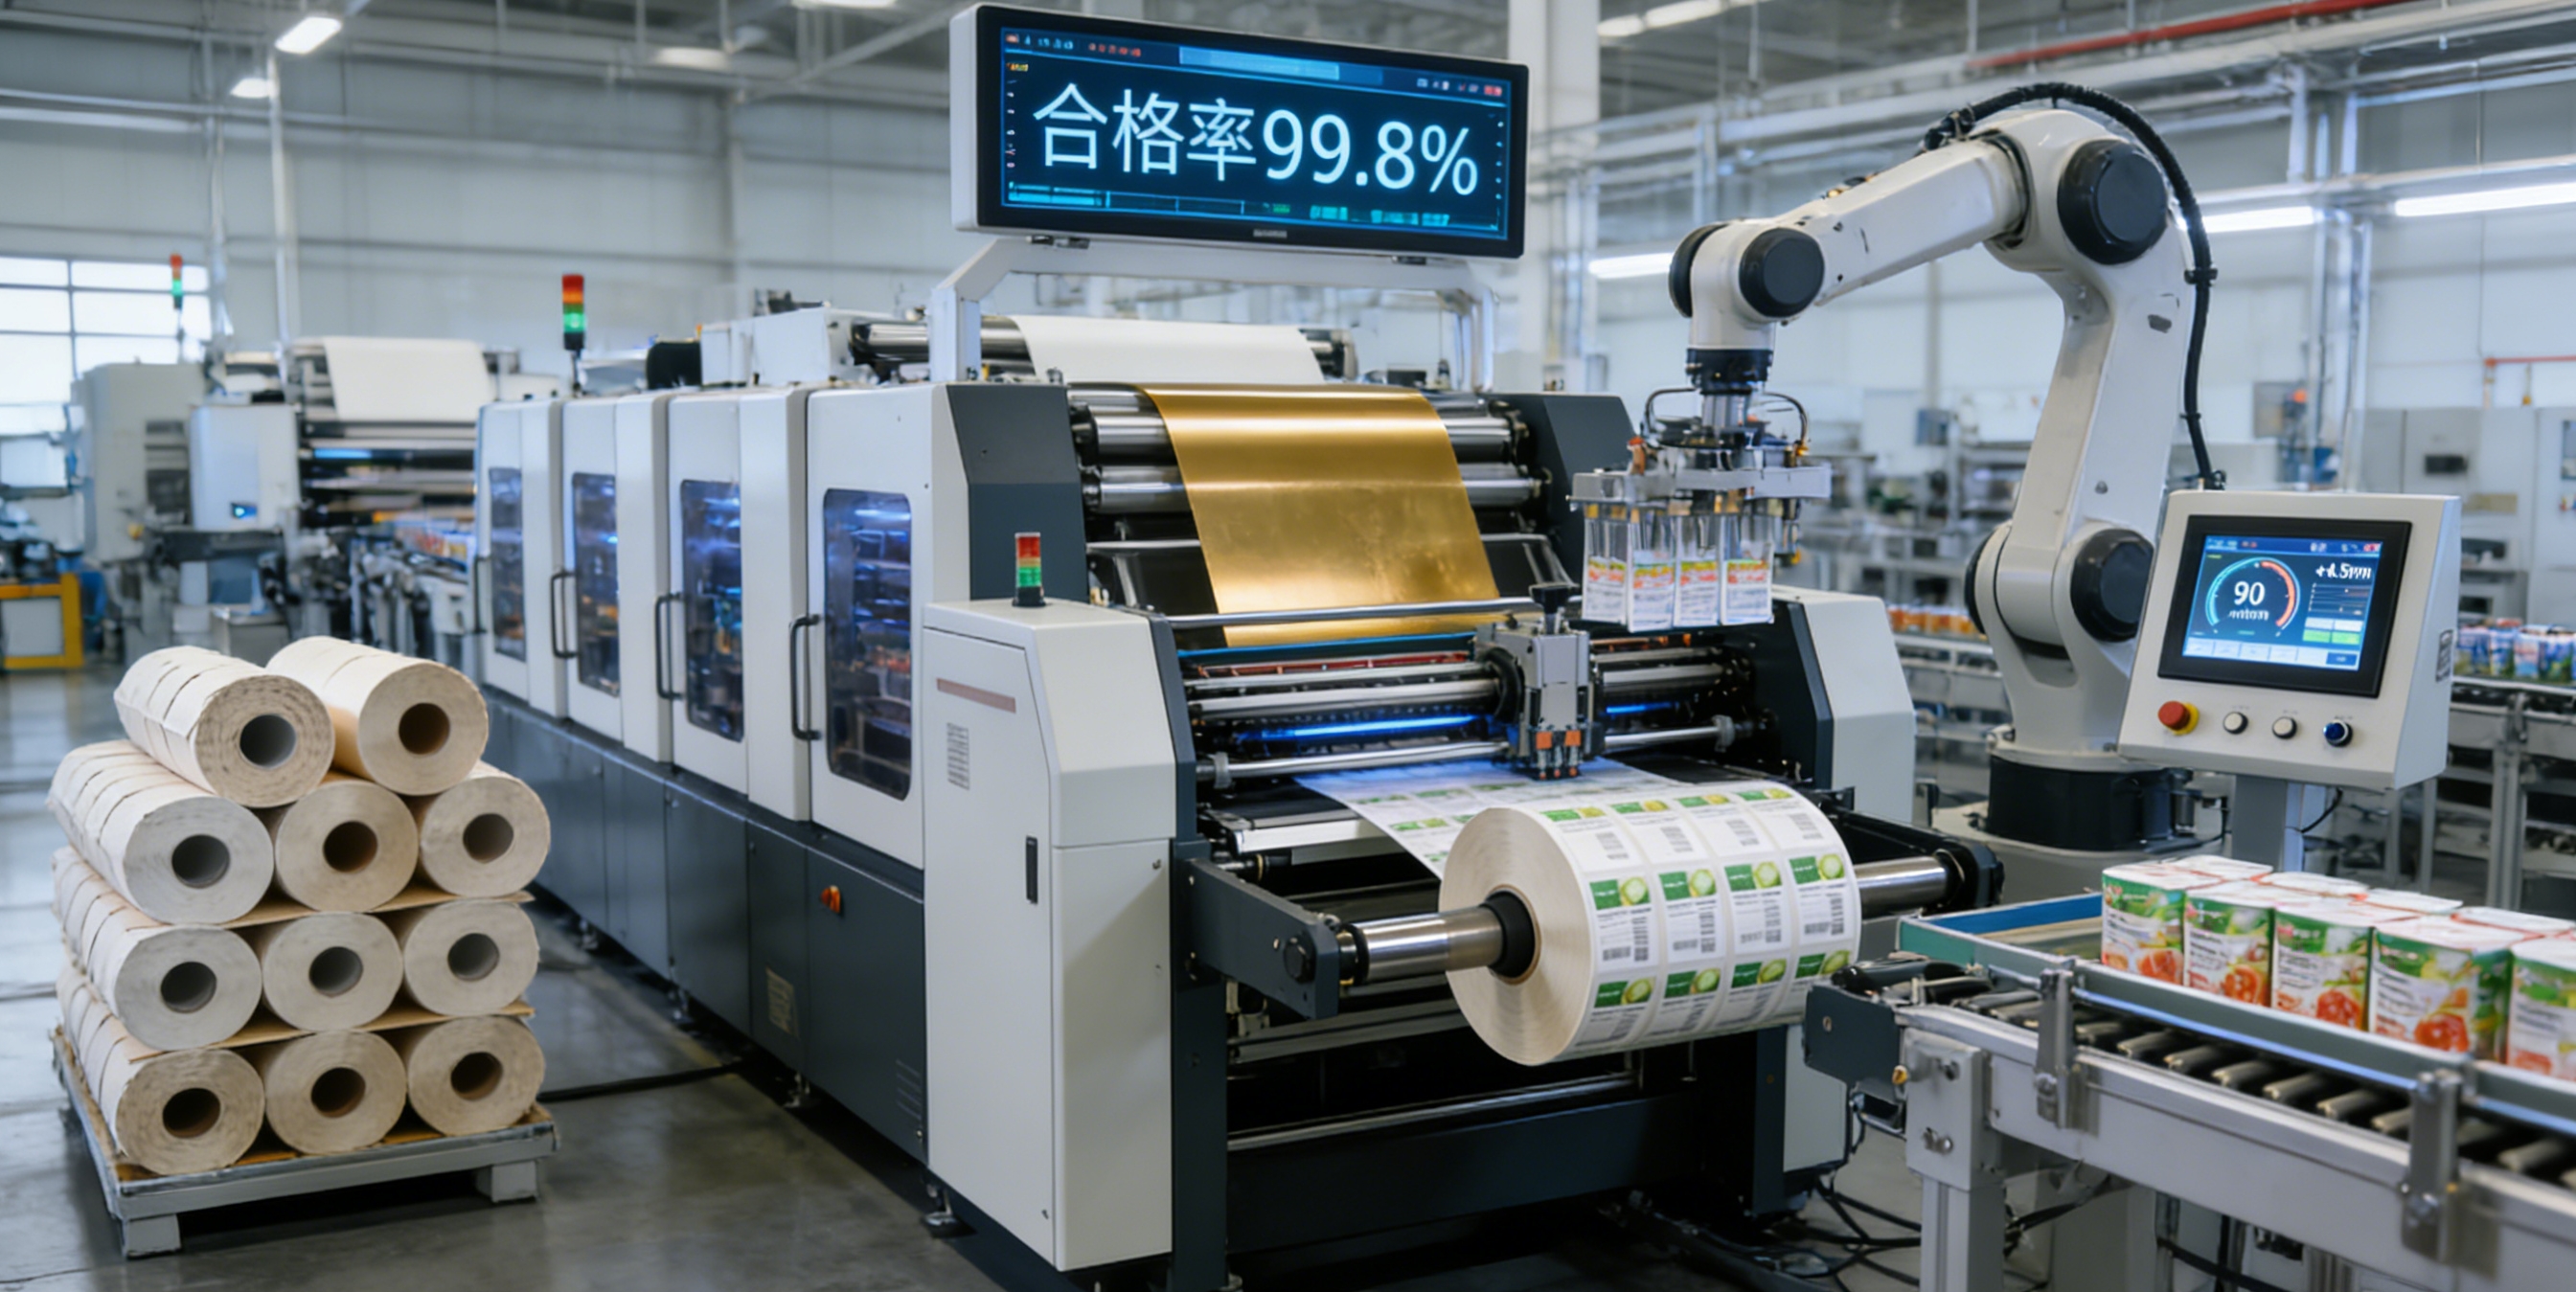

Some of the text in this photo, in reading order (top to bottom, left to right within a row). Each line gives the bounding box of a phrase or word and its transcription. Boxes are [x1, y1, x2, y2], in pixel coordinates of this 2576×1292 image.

[1034, 82, 1478, 195] 合格率99.8%
[2234, 580, 2266, 606] 90
